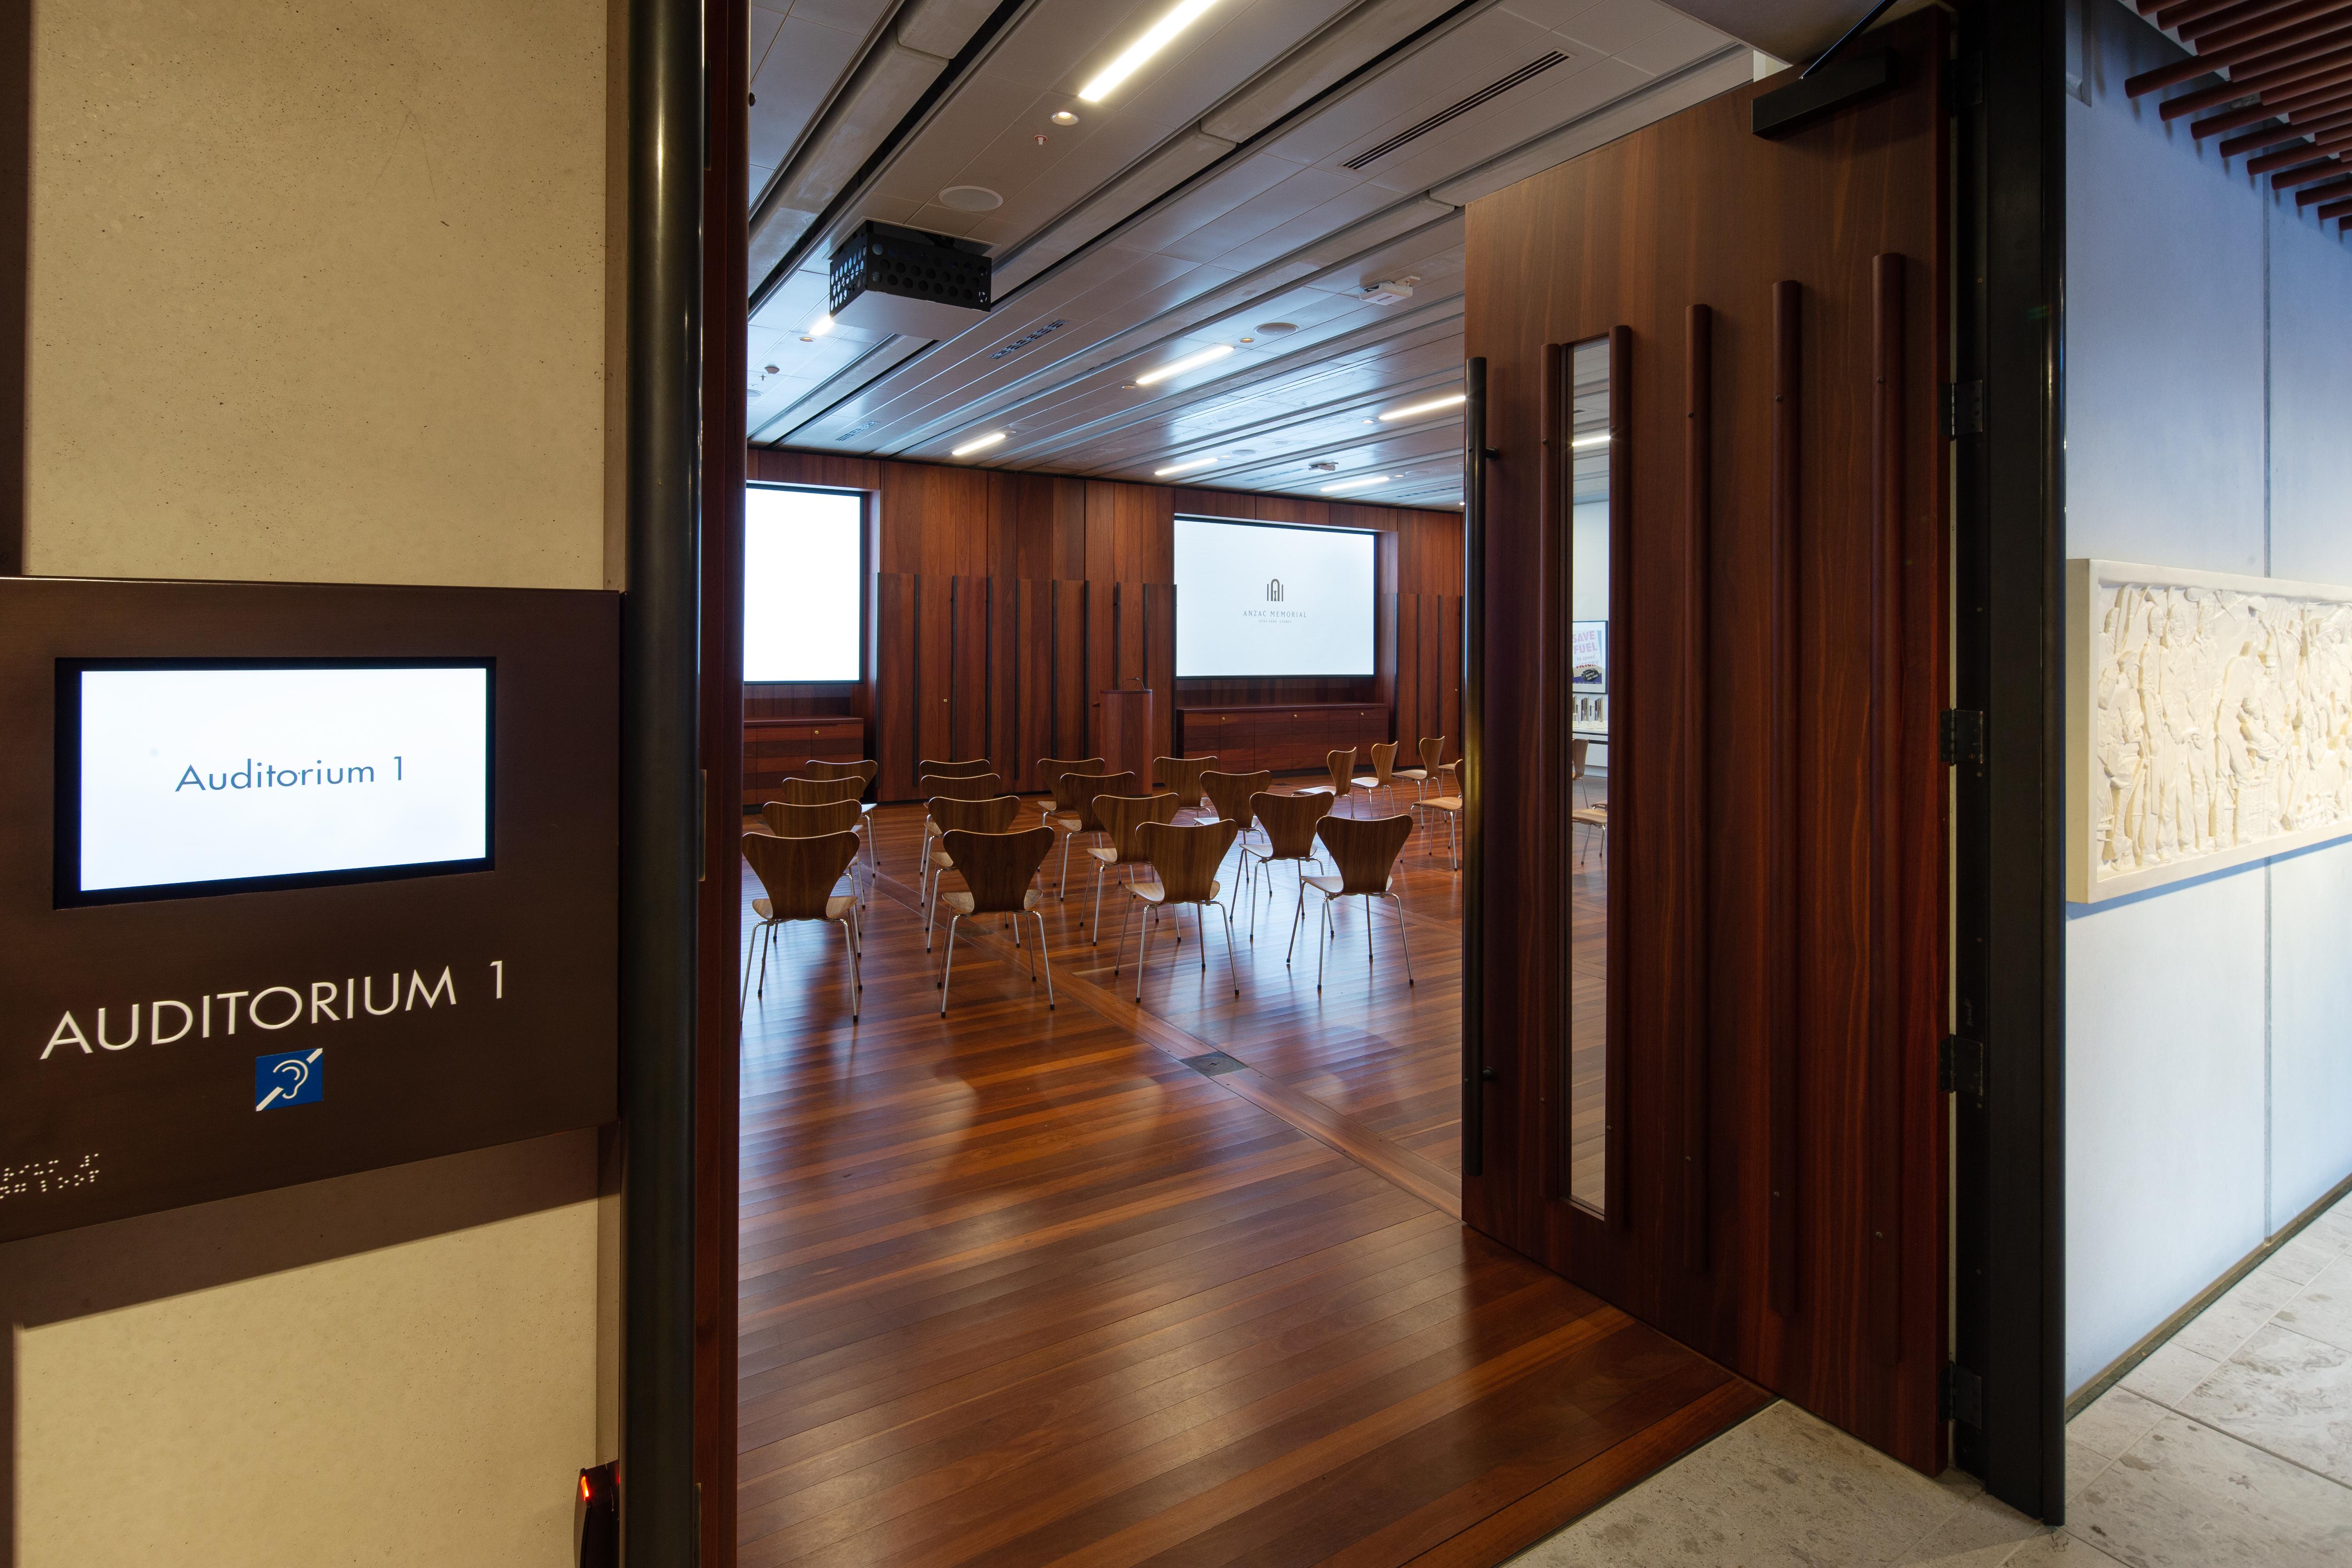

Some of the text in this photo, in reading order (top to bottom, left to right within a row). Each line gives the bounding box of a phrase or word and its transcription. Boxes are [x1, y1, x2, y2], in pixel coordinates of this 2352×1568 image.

[1573, 631, 1595, 643] SAVE
[1573, 642, 1597, 654] FUEL
[175, 756, 403, 792] Auditorium 1
[39, 960, 503, 1059] AUDITORIUM 1
